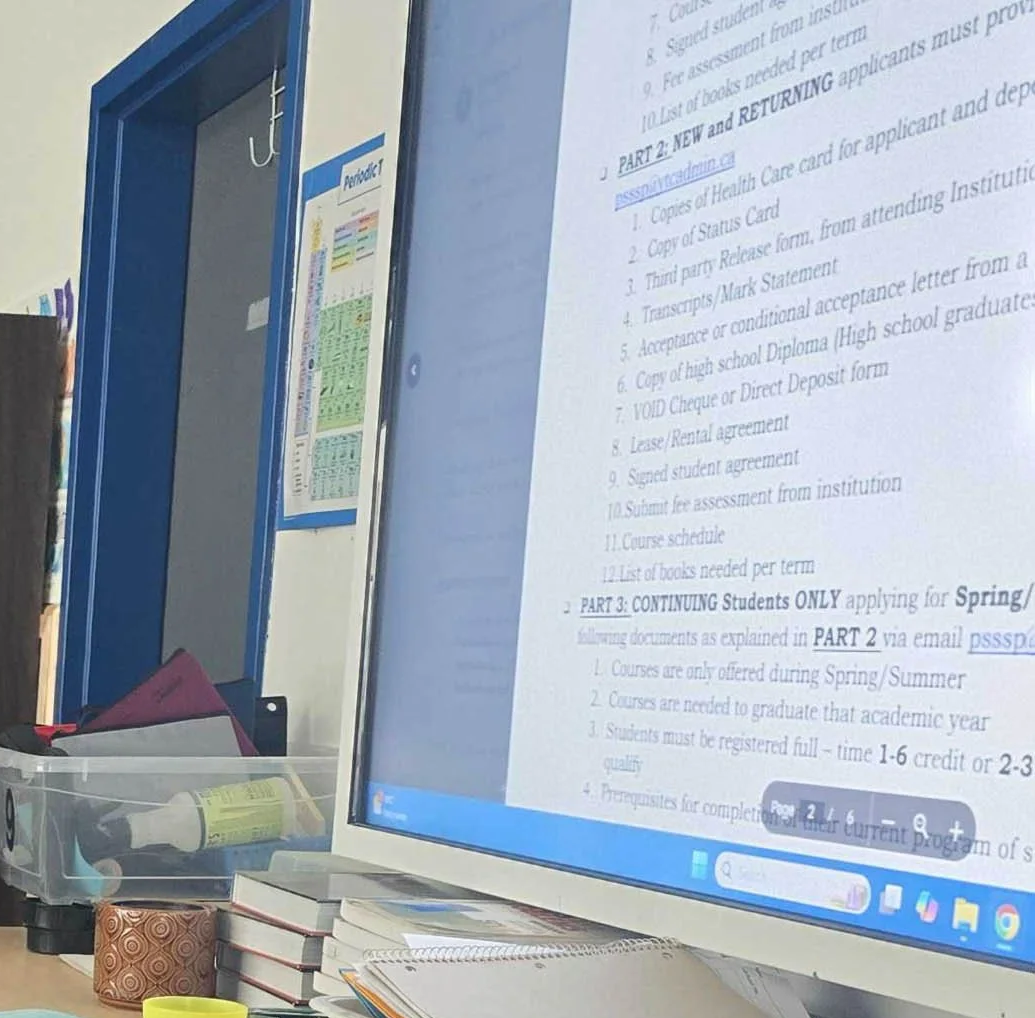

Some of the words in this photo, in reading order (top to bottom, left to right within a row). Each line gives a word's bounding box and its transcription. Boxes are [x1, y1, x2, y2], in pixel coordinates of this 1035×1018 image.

[664, 70, 686, 91] Fee
[688, 32, 766, 80] assessment
[770, 16, 805, 44] from
[666, 20, 710, 58] Signed
[712, 1, 765, 34] student
[702, 77, 742, 108] books
[744, 49, 798, 91] needed
[801, 42, 828, 73] per
[831, 25, 868, 53] term
[617, 144, 654, 175] PART
[655, 140, 670, 161] 2:
[673, 123, 706, 152] NEW
[707, 111, 735, 139] and
[737, 71, 834, 127] RETURNING
[838, 40, 926, 90] applicants
[931, 16, 980, 51] must
[342, 160, 378, 191] Periodic
[650, 199, 693, 226] Copies
[695, 187, 711, 211] of
[712, 170, 758, 206] Health
[761, 160, 795, 188] Care
[798, 142, 835, 174] card
[839, 136, 863, 162] for
[865, 107, 947, 156] applicant
[952, 88, 989, 122] and
[645, 264, 679, 291] Third
[682, 255, 717, 286] party
[719, 241, 772, 271] Release
[820, 217, 857, 242] from
[861, 189, 947, 229] attending
[648, 233, 680, 262] Copy
[682, 223, 698, 248] of
[698, 215, 742, 242] Status
[745, 197, 781, 228] Card
[638, 326, 710, 358] Acceptance
[712, 322, 729, 341] or
[730, 296, 812, 335] conditional
[814, 280, 907, 317] acceptance
[910, 266, 961, 294] letter
[963, 255, 1010, 283] from
[1015, 250, 1029, 271] a
[642, 275, 757, 325] Transcripts/Mark
[760, 257, 839, 294] Statement
[636, 368, 668, 393] Copy
[669, 359, 684, 384] of
[685, 356, 715, 384] high
[717, 343, 763, 373] school
[766, 335, 831, 365] Diploma
[883, 304, 940, 339] school
[634, 398, 666, 422] VOID
[669, 389, 719, 416] Cheque
[721, 389, 737, 406] or
[740, 379, 784, 403] Direct
[788, 361, 846, 397] Deposit
[850, 357, 891, 382] form
[630, 422, 714, 456] Lease/Rental
[716, 414, 790, 445] agreement
[628, 463, 669, 490] Signed
[672, 458, 722, 481] student
[725, 449, 801, 479] agreement
[672, 494, 690, 515] fee
[693, 487, 774, 513] assessment
[778, 481, 813, 504] from
[817, 472, 904, 501] institution
[667, 524, 726, 546] schedule
[644, 561, 659, 581] of
[660, 560, 696, 581] books
[700, 557, 749, 580] needed
[752, 562, 777, 582] per
[780, 558, 817, 576] term
[580, 596, 615, 615] PART
[631, 593, 719, 614] CONTINUING
[721, 591, 790, 611] Students
[795, 589, 843, 611] ONLY
[845, 586, 921, 616] applying
[924, 584, 950, 610] for
[577, 628, 628, 650] following
[630, 628, 699, 647] documents
[702, 631, 718, 647] as
[721, 627, 789, 652] explained
[794, 628, 810, 647] in
[814, 627, 863, 648] PART
[866, 627, 879, 647] 2
[884, 626, 909, 648] via
[913, 625, 964, 649] email
[611, 658, 660, 680] Courses
[663, 663, 685, 679] are
[687, 660, 716, 686] only
[719, 661, 766, 683] offered
[769, 662, 821, 690] during
[825, 663, 967, 692] Spring/Summer
[608, 690, 657, 712] Courses
[661, 696, 683, 713] are
[684, 695, 732, 716] needed
[734, 698, 748, 717] to
[752, 698, 819, 724] graduate
[824, 701, 857, 723] that
[861, 703, 945, 729] academic
[948, 712, 993, 737] year
[603, 753, 644, 777] qualify
[606, 720, 660, 745] Students
[663, 729, 696, 747] must
[699, 728, 715, 749] be
[719, 732, 790, 758] registered
[793, 735, 820, 759] full
[837, 740, 874, 762] time
[880, 742, 909, 768] 1-6
[913, 747, 966, 773] credit
[972, 755, 993, 774] or
[601, 782, 677, 811] Prerequisites
[682, 792, 700, 814] for
[844, 819, 907, 846] current
[913, 825, 991, 858] program
[998, 837, 1019, 862] of
[806, 803, 817, 820] 2
[846, 809, 856, 825] 6
